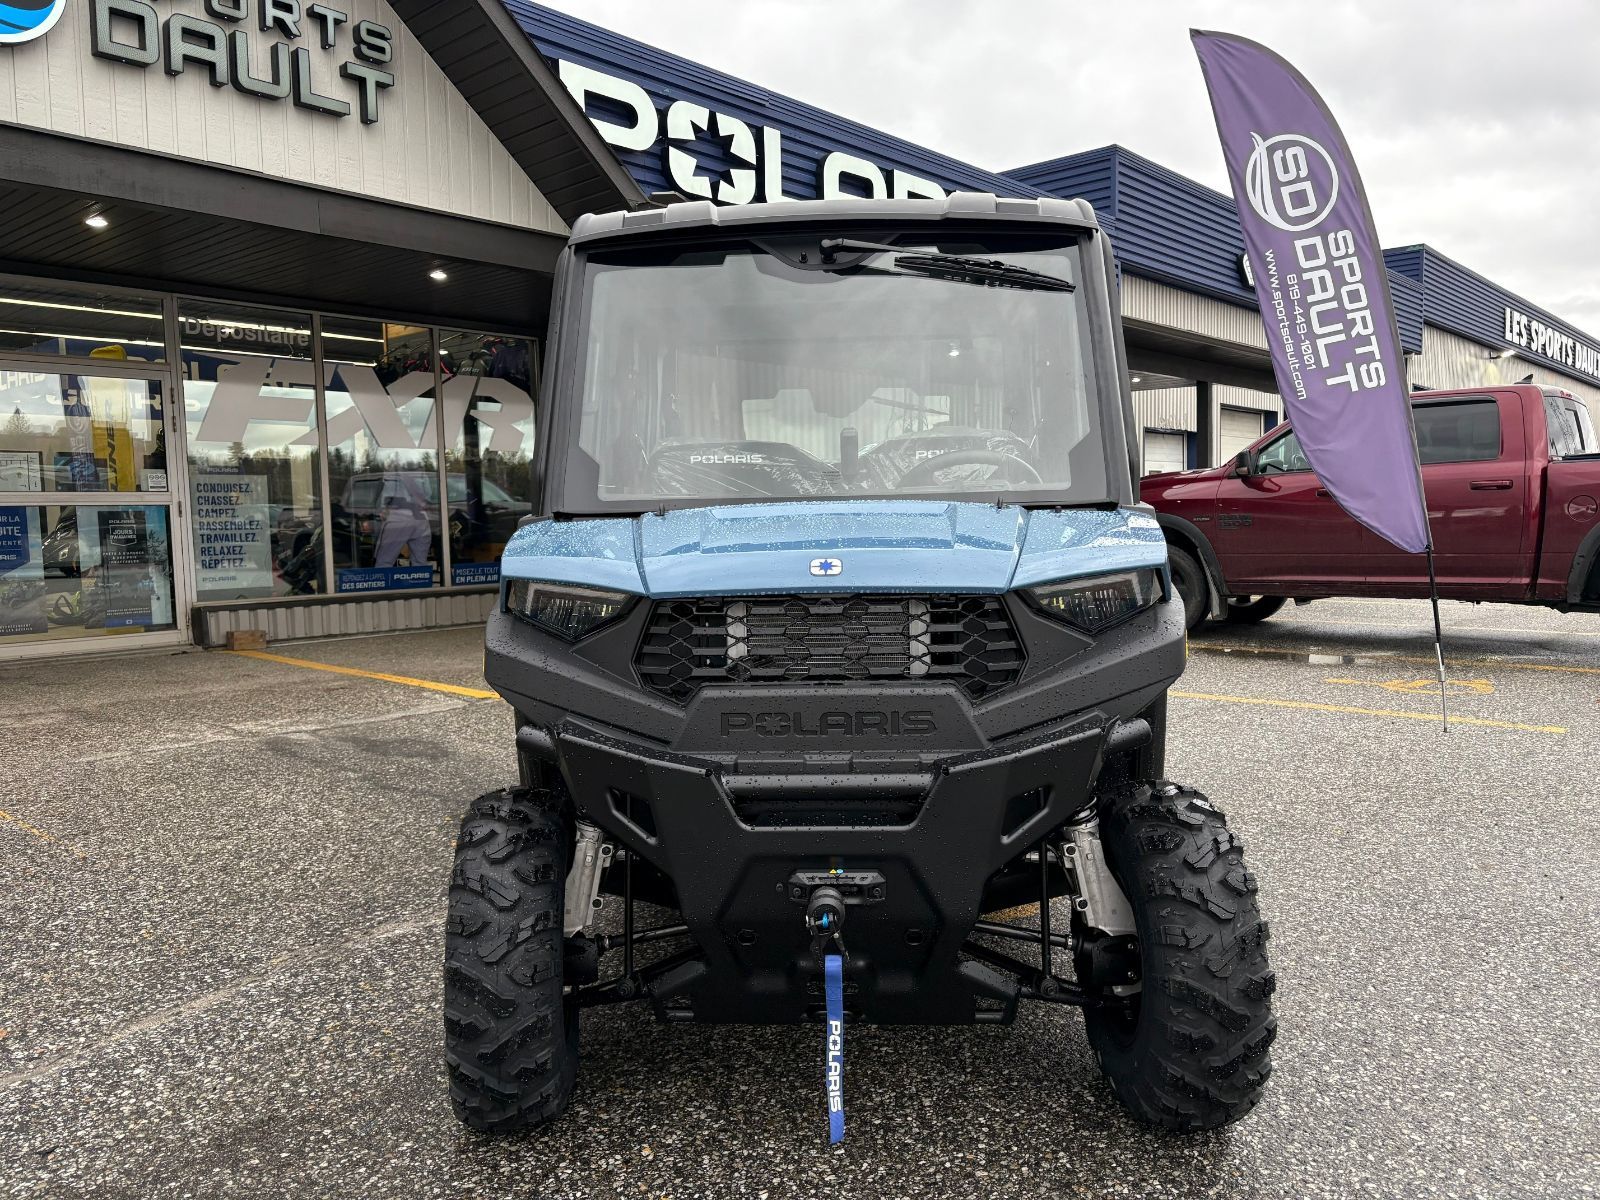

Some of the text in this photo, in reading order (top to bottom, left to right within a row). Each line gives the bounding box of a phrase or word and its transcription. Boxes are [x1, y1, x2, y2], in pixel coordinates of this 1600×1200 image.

[89, 0, 394, 124] DAULT
[1273, 145, 1318, 217] SD
[1293, 235, 1359, 392] DAULT
[1327, 229, 1387, 389] SPORTS
[1264, 249, 1307, 401] www.sportsdault.com
[1287, 273, 1317, 371] 819-449-1001
[184, 316, 310, 347] Dépositaire
[1504, 307, 1528, 347] LES
[1530, 320, 1574, 366] SPORTS
[195, 356, 536, 451] FXR
[690, 455, 762, 464] POLARIS
[196, 483, 253, 493] CONDUISEZ.
[197, 495, 244, 506] CHASSEZ.
[198, 508, 240, 518] CAMPEZ.
[199, 520, 263, 531] RASSEMBLEZ.
[199, 533, 260, 544] TRAVAILLEZ.
[200, 546, 247, 557] RELAXEZ.
[201, 556, 247, 569] RÉPÉTEZ.
[393, 572, 430, 580] POLARIS
[456, 568, 474, 576] MISEZ
[483, 566, 499, 574] TOUT
[355, 581, 385, 589] SENTIERS
[466, 575, 486, 583] PLEIN
[487, 574, 499, 582] AIR
[720, 711, 937, 737] POLARIS
[828, 1020, 842, 1113] POLARIS
